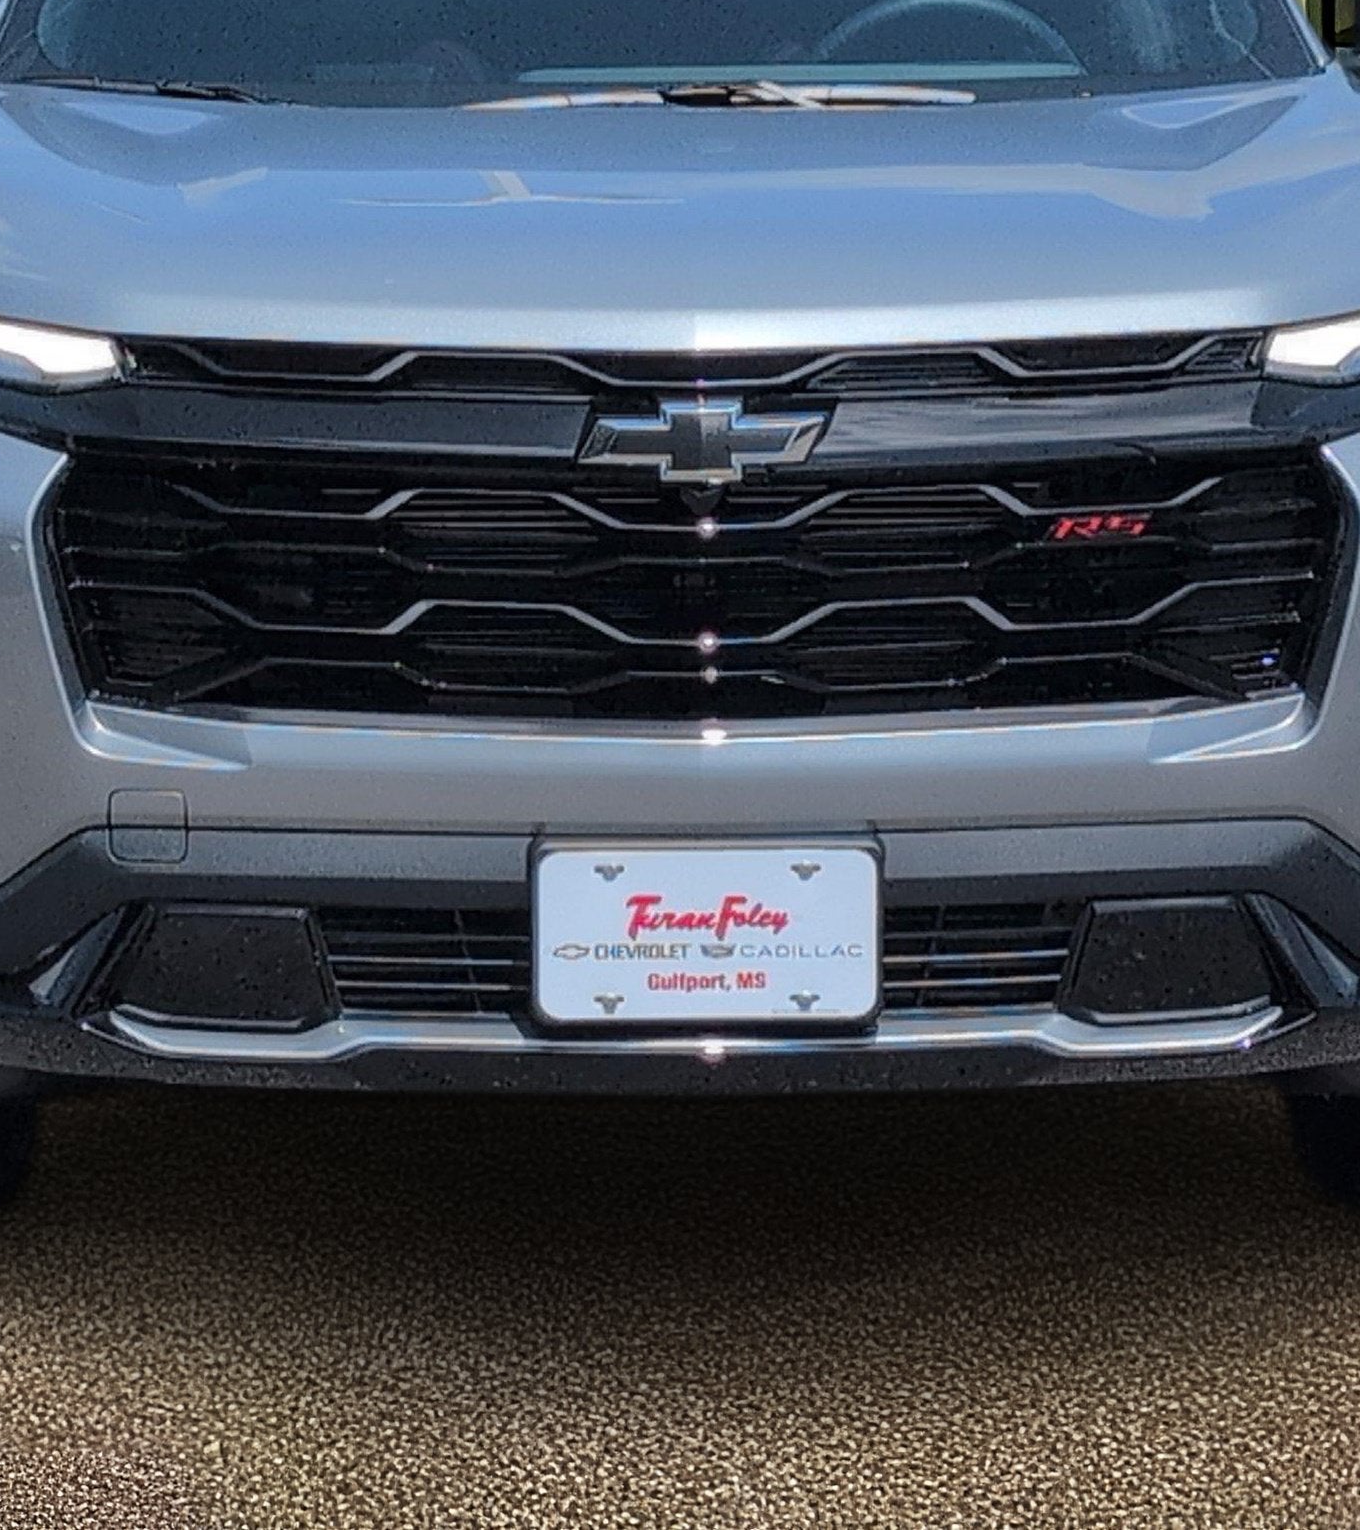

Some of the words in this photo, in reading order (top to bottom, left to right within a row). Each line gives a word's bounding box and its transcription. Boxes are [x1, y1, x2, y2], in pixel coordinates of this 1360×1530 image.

[1053, 515, 1147, 540] RS
[594, 943, 689, 960] CHEVROLET
[740, 944, 864, 958] CADILLAC
[648, 972, 731, 992] Gulfport,
[737, 972, 767, 989] MS
